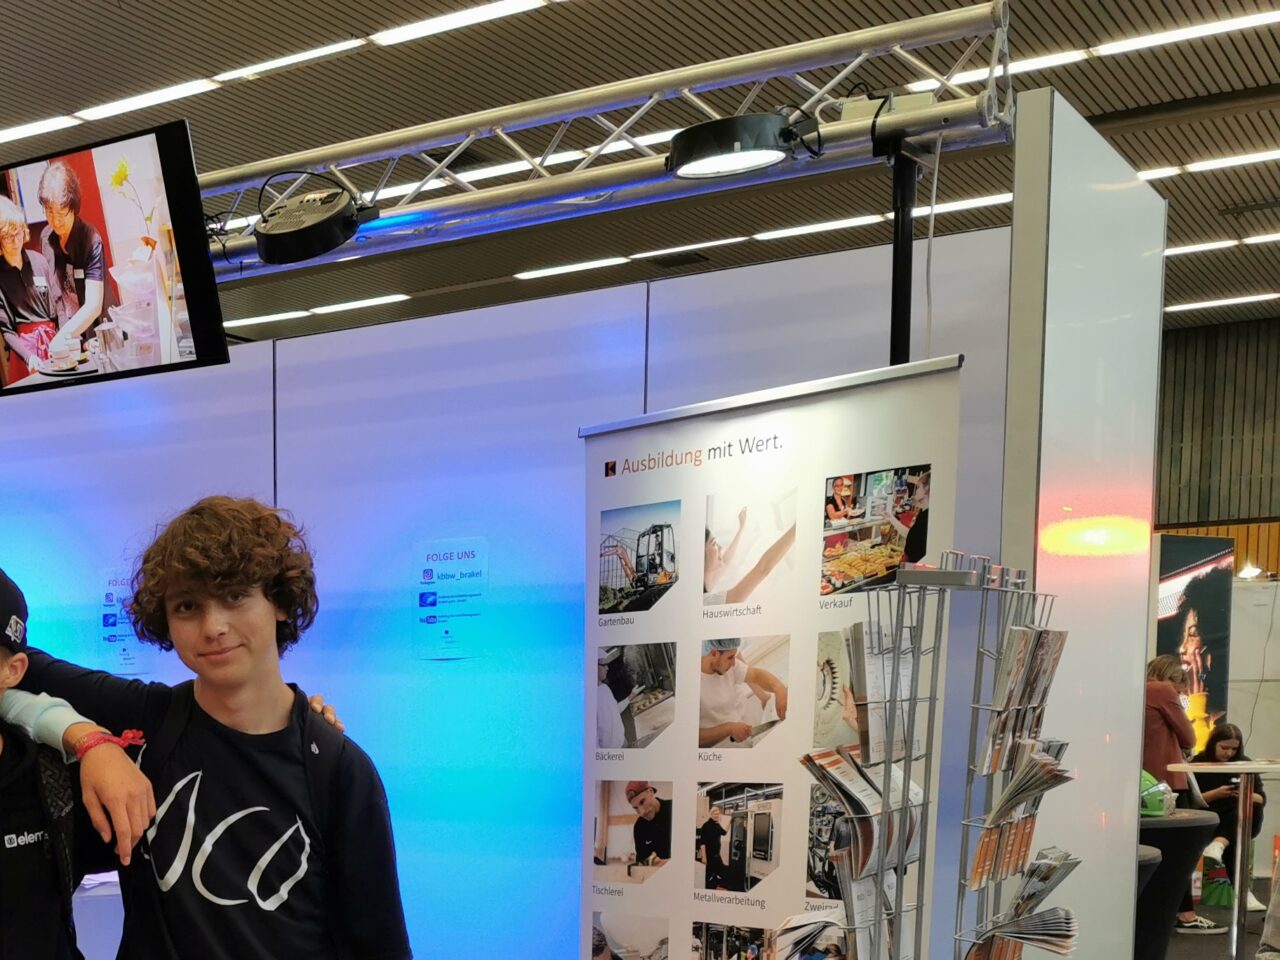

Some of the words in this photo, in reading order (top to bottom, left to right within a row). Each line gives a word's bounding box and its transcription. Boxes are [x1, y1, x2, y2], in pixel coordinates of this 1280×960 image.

[621, 449, 703, 475] Ausbildung
[707, 440, 733, 460] mit
[738, 433, 783, 454] Wert.
[426, 552, 455, 562] FOLGE
[457, 550, 476, 560] UNS
[819, 596, 853, 611] Verkauf
[702, 605, 762, 619] Hauswirtschaft
[598, 615, 635, 628] Gartenbau
[595, 752, 625, 761] Bäckerei
[698, 752, 723, 762] Küche
[17, 831, 48, 846] elem
[592, 885, 624, 897] Tischlerei
[693, 891, 766, 910] Metallverarbeitung
